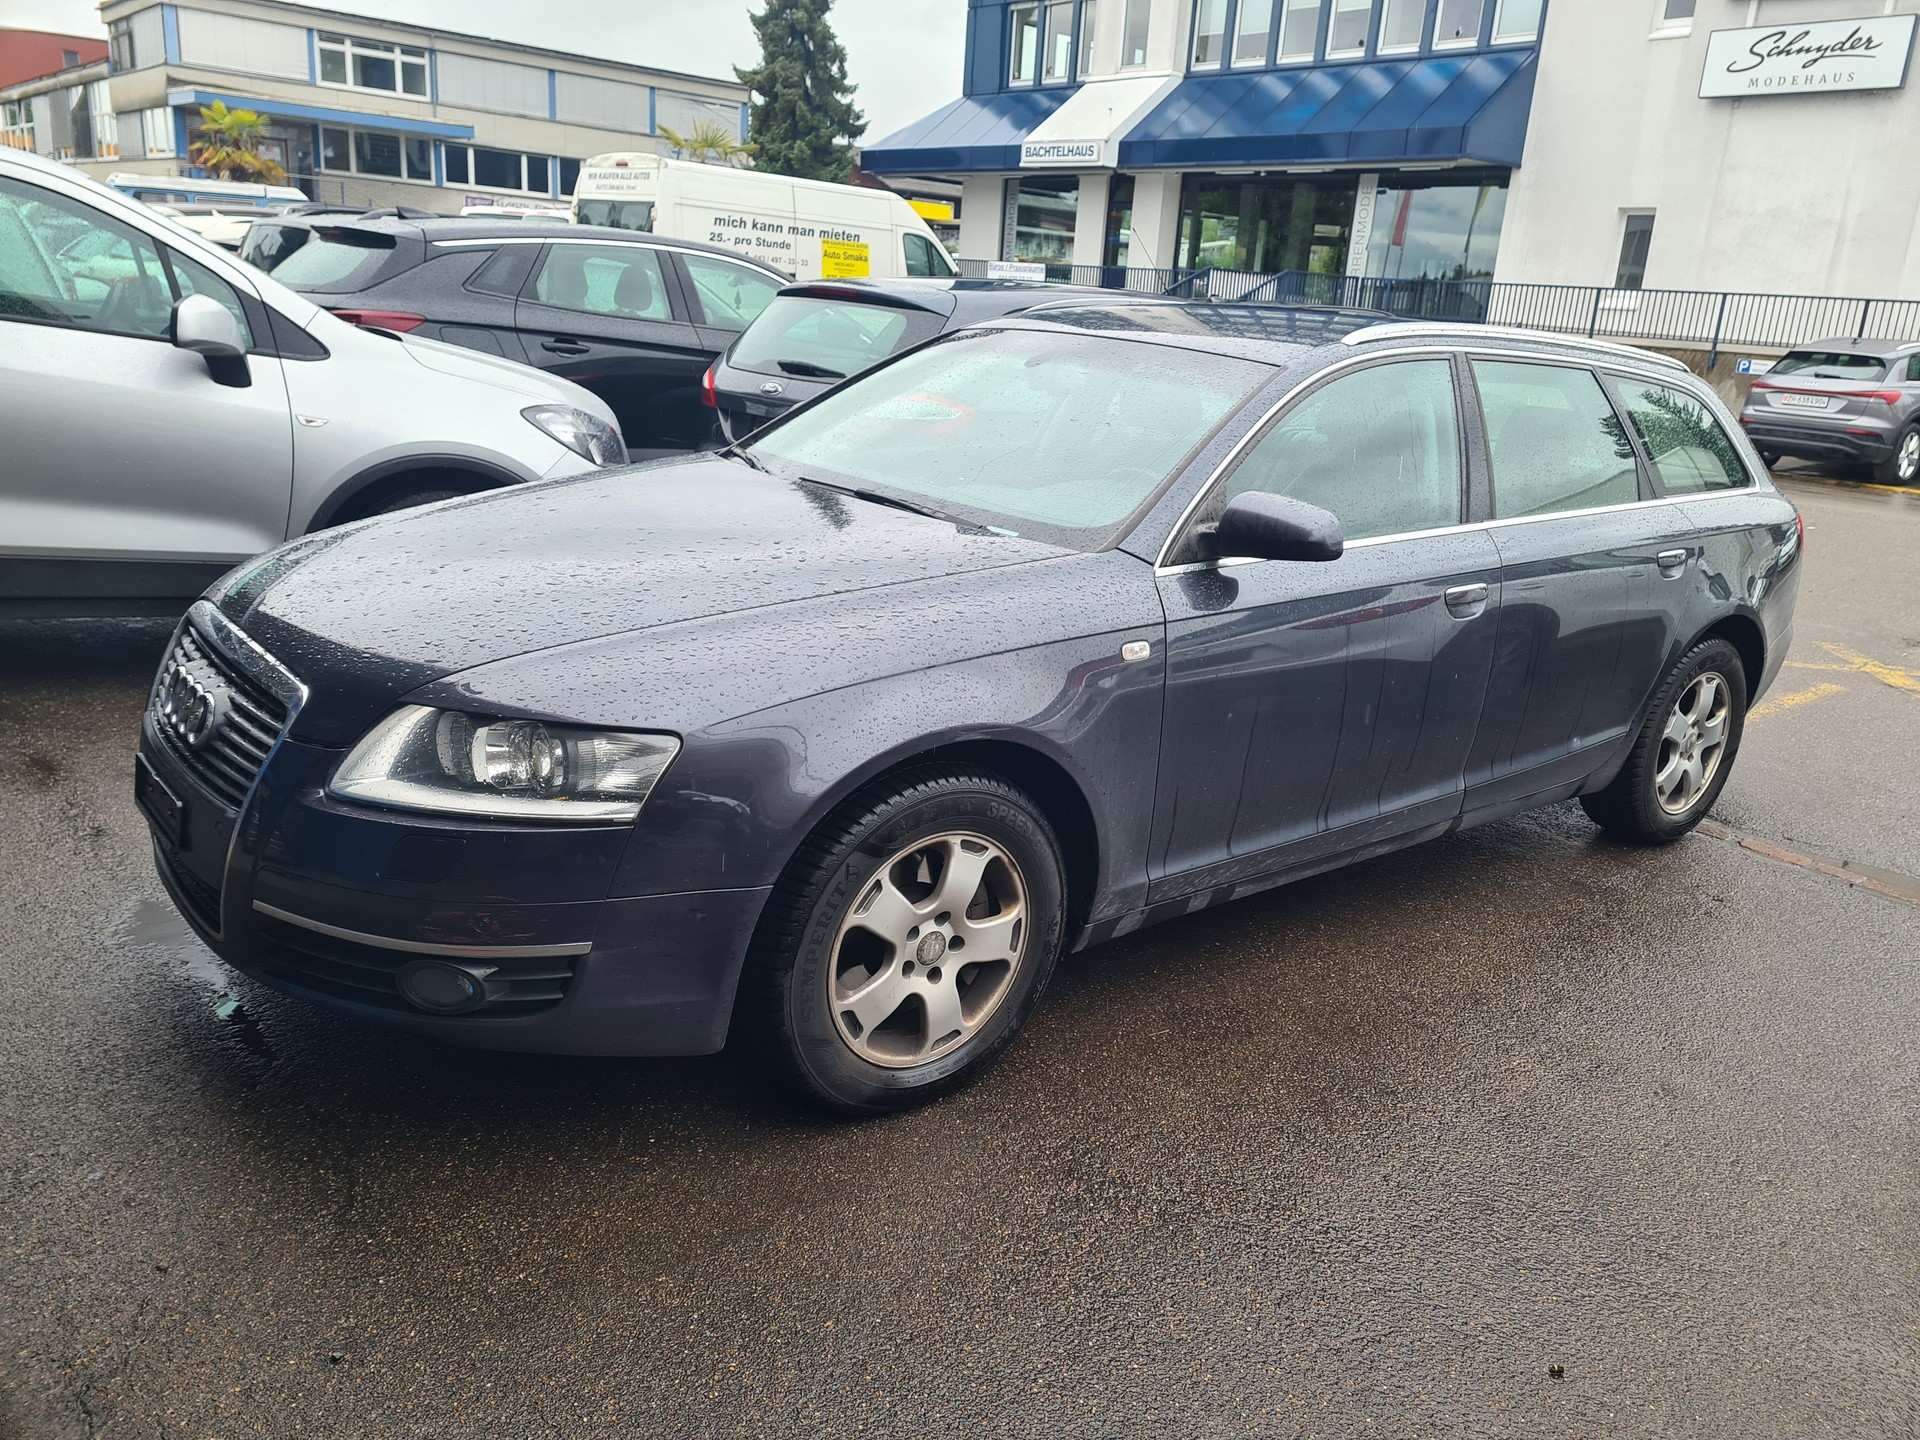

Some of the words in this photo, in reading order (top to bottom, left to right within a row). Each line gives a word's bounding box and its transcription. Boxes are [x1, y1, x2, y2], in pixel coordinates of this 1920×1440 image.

[1726, 26, 1884, 73] Schnyder
[1748, 72, 1855, 88] MODEHAUS
[1025, 145, 1095, 157] BACHTELHAUS
[714, 215, 747, 229] mich
[751, 218, 784, 234] kann
[788, 226, 815, 238] man
[818, 228, 861, 242] mieten
[1350, 185, 1374, 276] RRENMODE
[709, 232, 731, 243] 25.-
[734, 236, 752, 246] pro
[755, 237, 792, 250] Stunde
[823, 249, 842, 259] Auto
[842, 251, 869, 263] Smaka
[1739, 361, 1750, 373] P
[802, 880, 848, 1024] SEMPERIT
